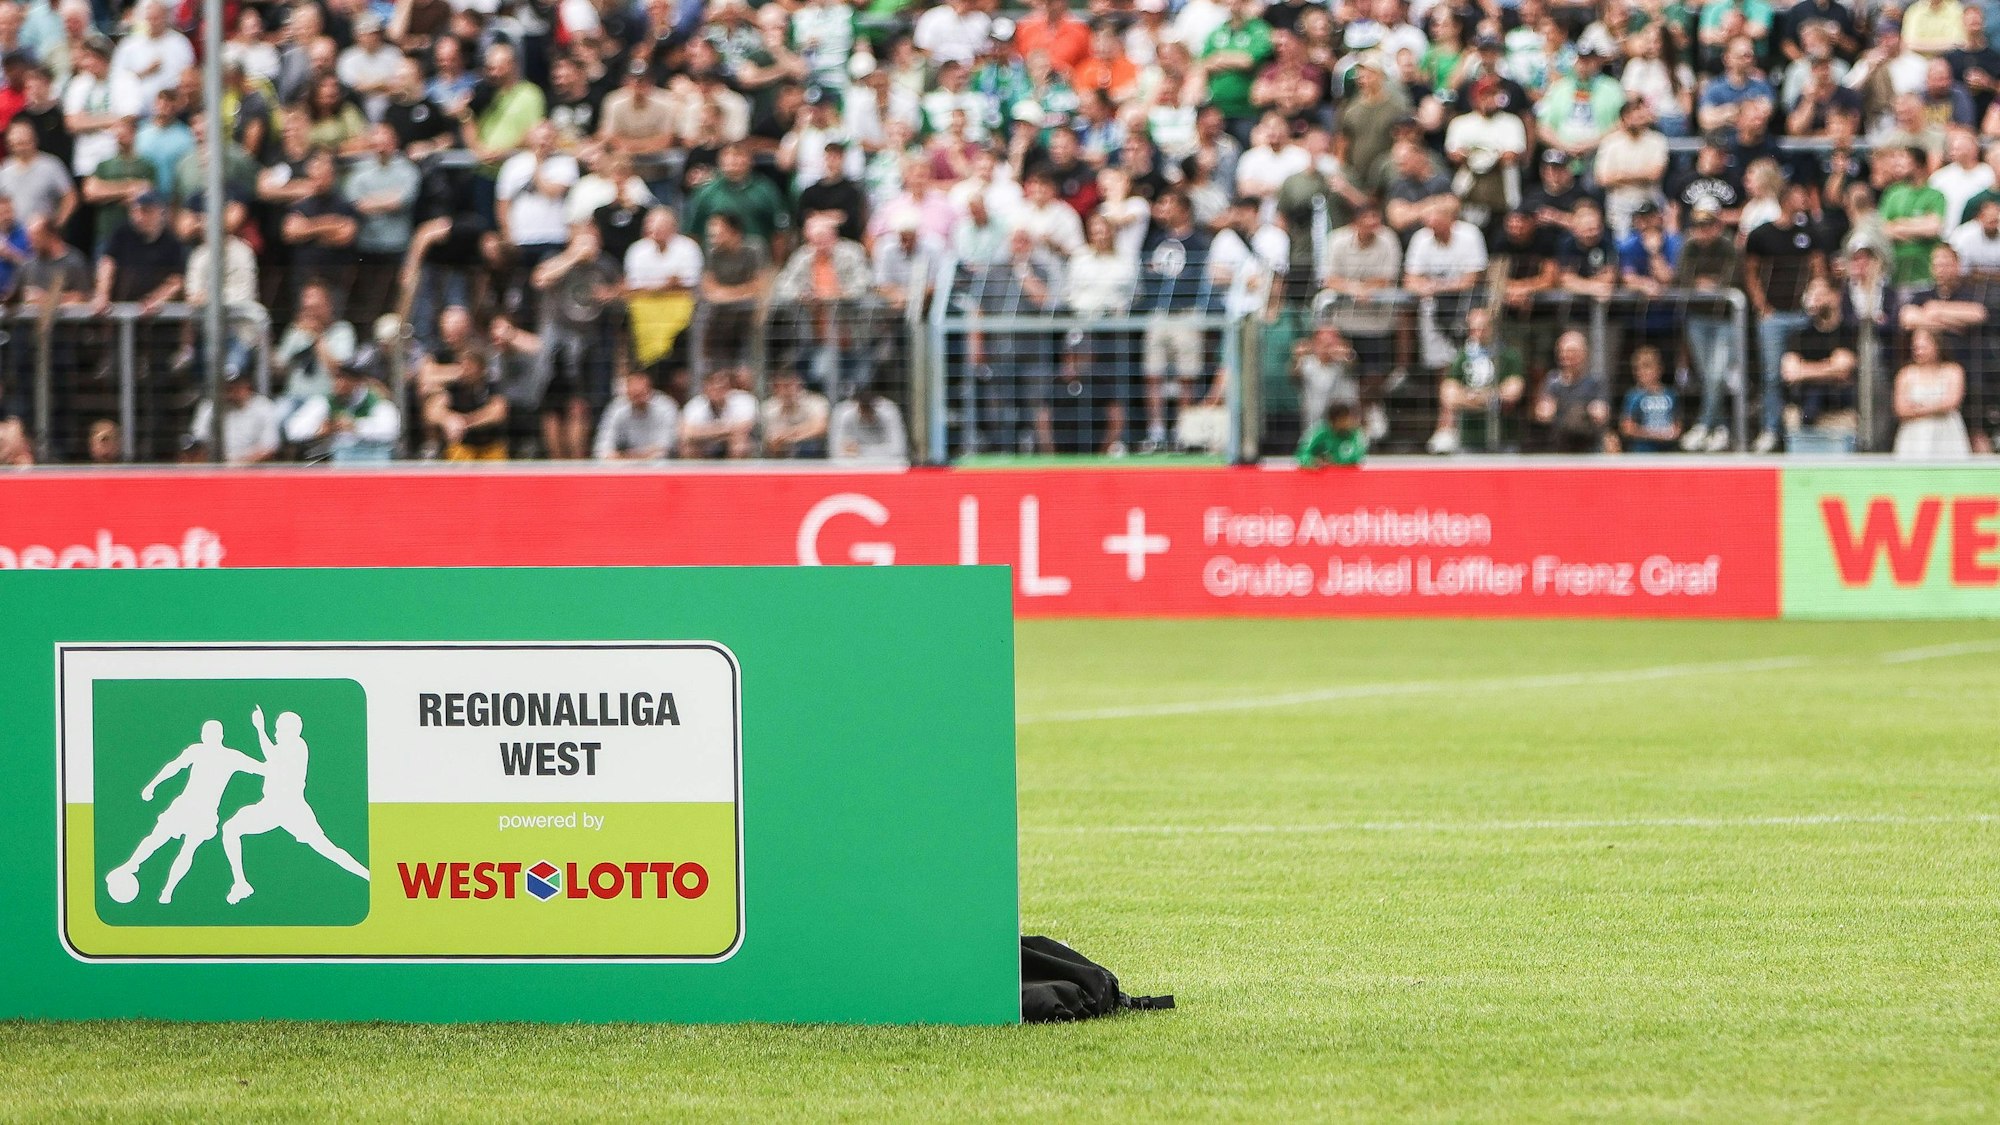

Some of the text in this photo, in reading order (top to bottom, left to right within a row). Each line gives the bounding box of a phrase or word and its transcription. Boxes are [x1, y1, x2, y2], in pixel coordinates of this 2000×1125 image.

[1203, 506, 1491, 547] Freie Architekten
[1203, 555, 1314, 597] Grube
[1640, 554, 1721, 596] Graf
[418, 692, 681, 727] REGIONALLIGA
[499, 741, 602, 776] WEST
[499, 811, 605, 832] powered by
